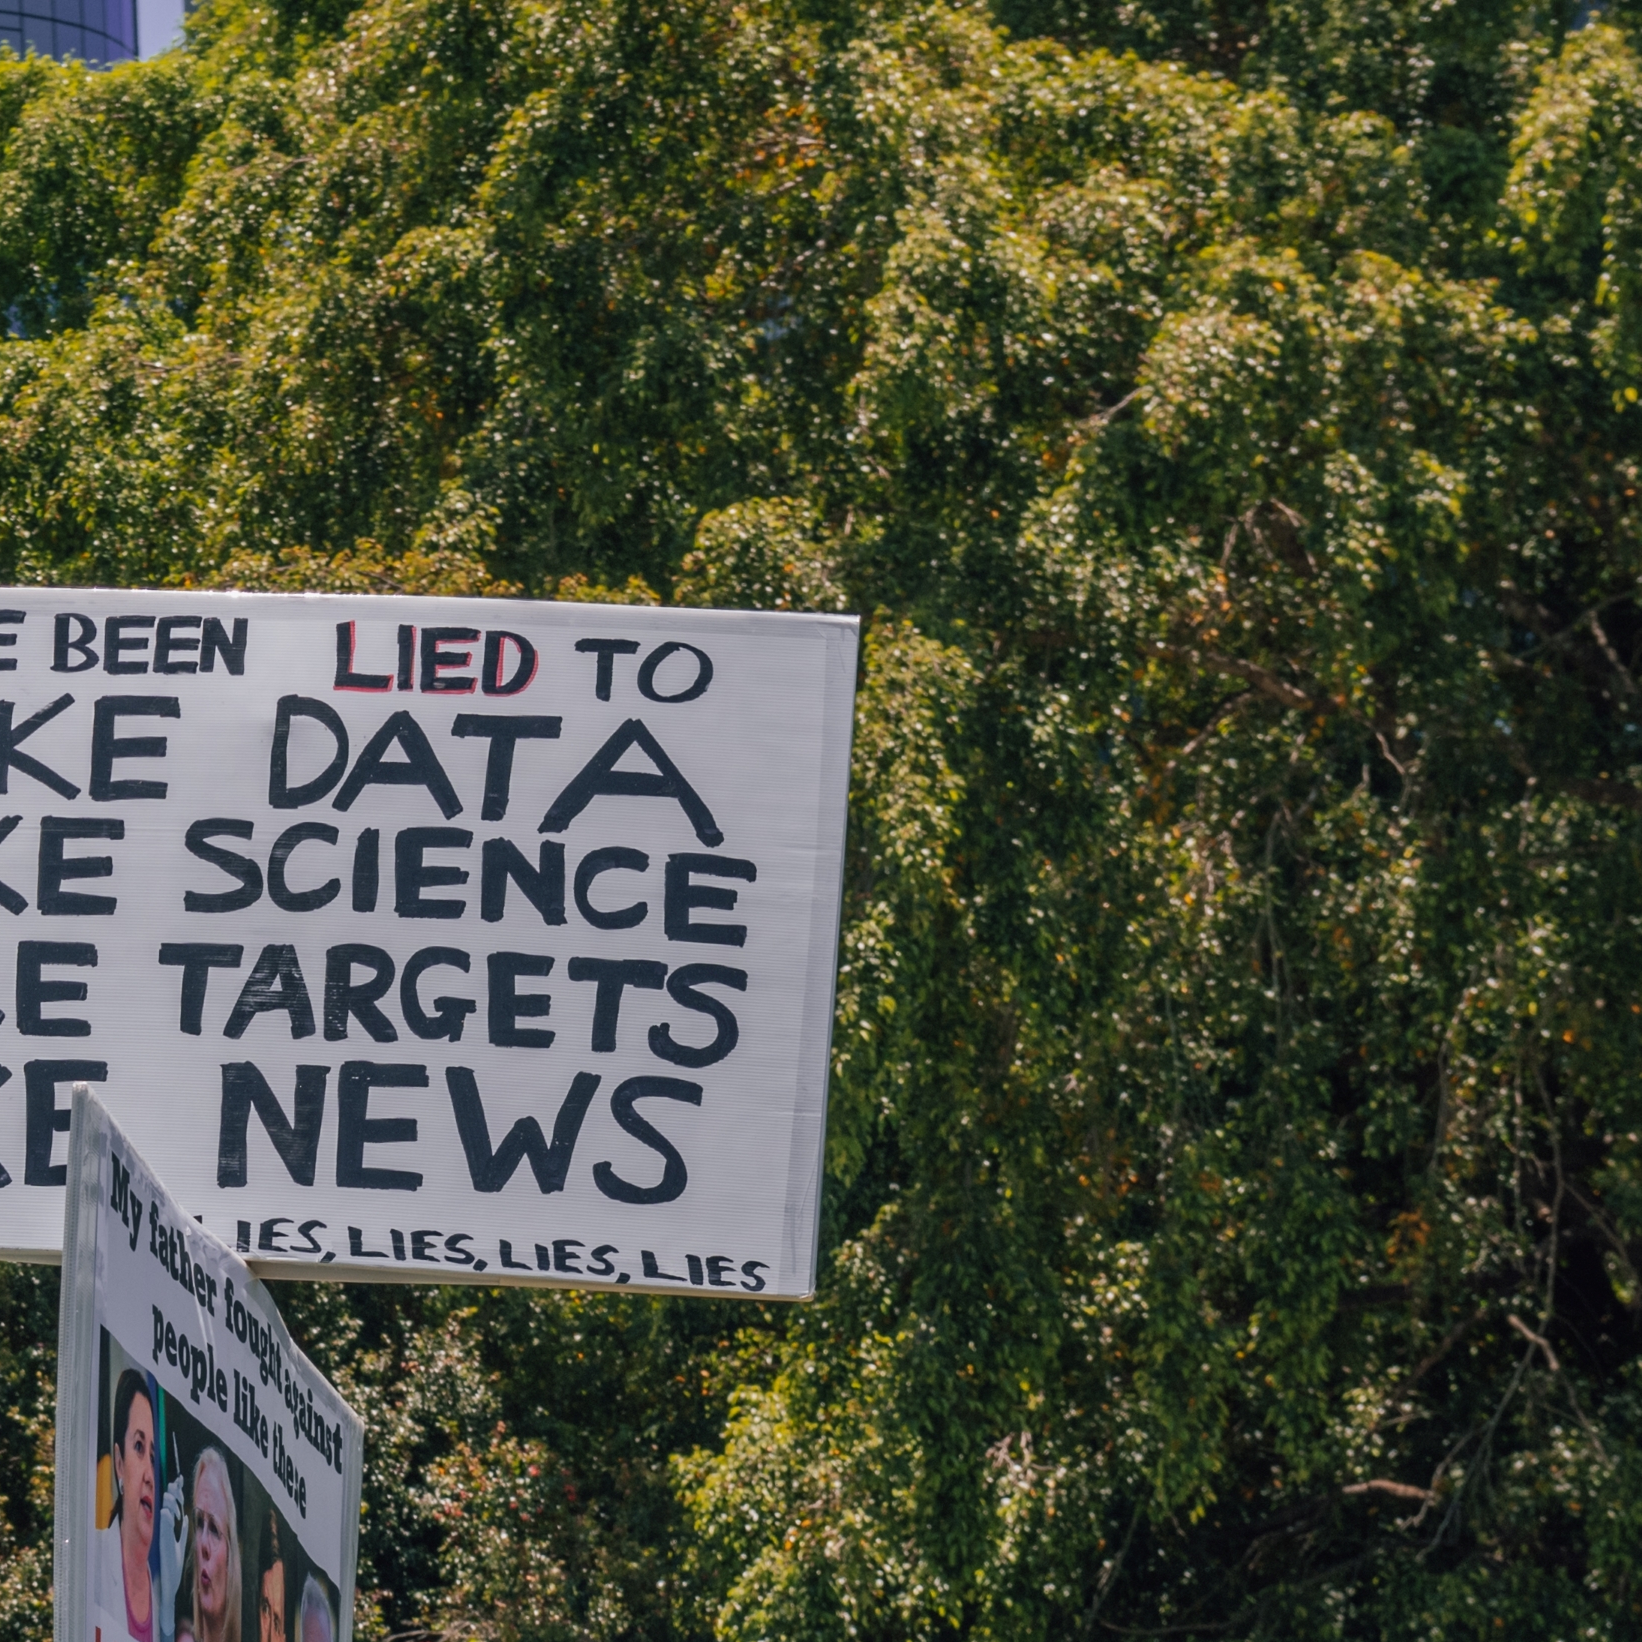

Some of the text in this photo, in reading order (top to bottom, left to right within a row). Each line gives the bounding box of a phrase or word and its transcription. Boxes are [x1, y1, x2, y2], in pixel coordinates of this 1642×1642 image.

[51, 614, 247, 675] BEEN
[333, 620, 539, 697] LIED
[575, 639, 713, 703] TO
[269, 695, 724, 847] DATA
[184, 818, 757, 947] SCIENCE
[159, 943, 748, 1068] TARGETS
[217, 1061, 703, 1204] NEWS
[110, 1151, 343, 1475] My father fought against
[194, 1214, 769, 1294] IES, LIES, LIES, LIES
[152, 1304, 228, 1413] people
[234, 1369, 268, 1459] like
